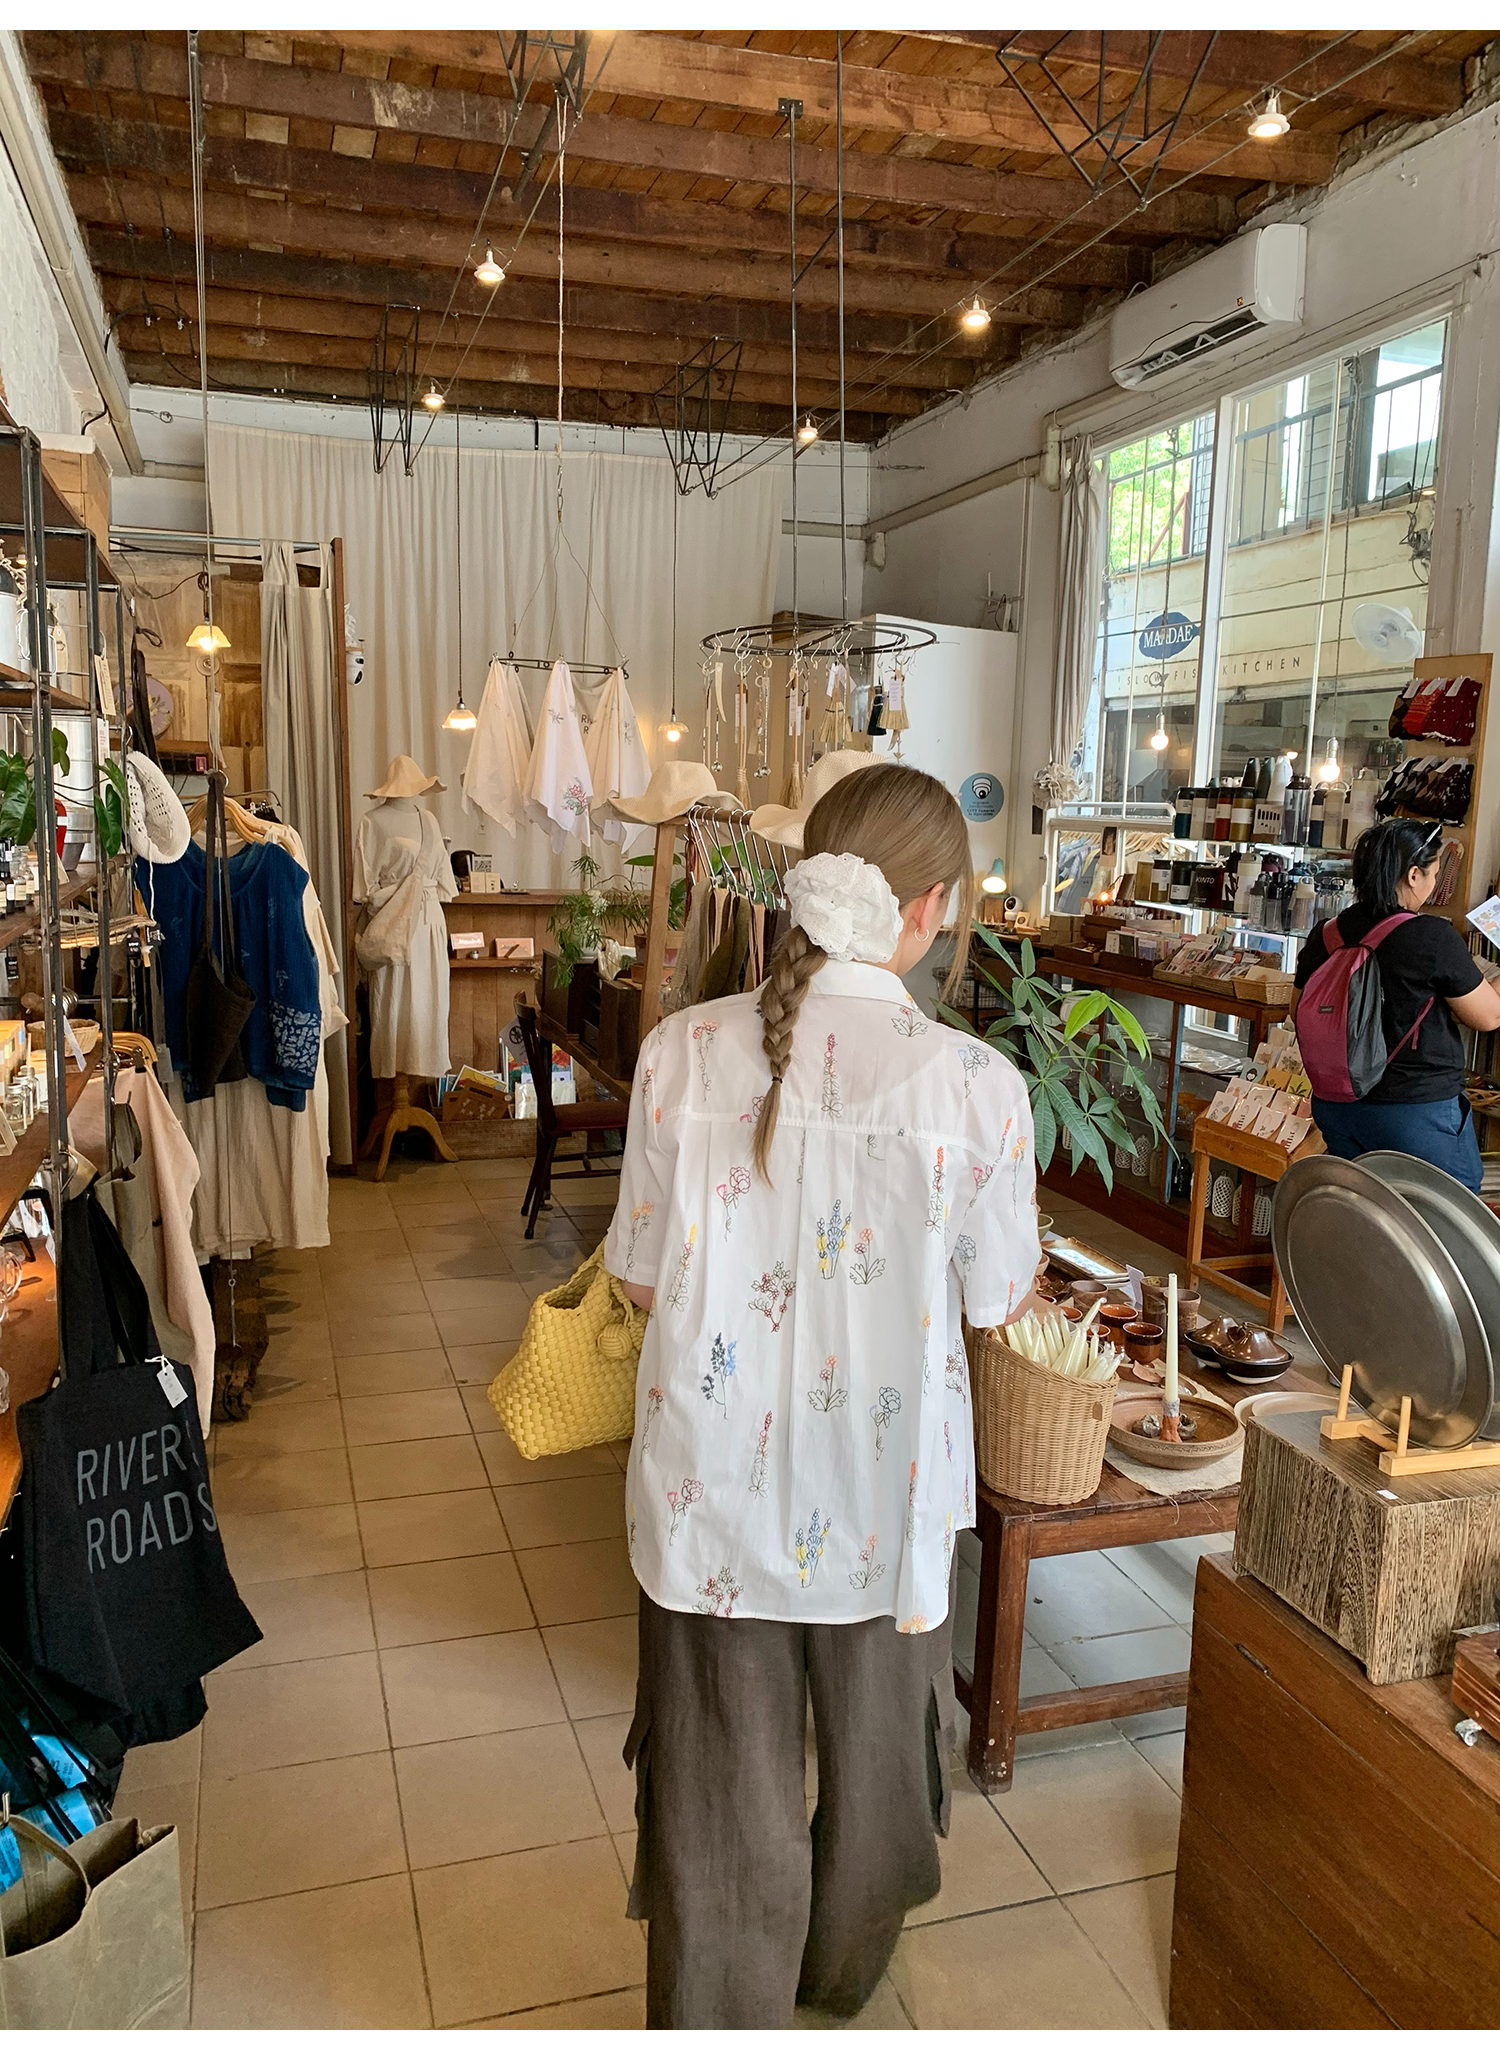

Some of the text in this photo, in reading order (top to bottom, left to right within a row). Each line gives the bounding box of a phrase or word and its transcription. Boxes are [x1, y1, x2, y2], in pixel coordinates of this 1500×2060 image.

[1173, 668, 1198, 682] FIS
[1222, 656, 1301, 676] KITCHEN
[1195, 876, 1215, 884] KINTO
[86, 1482, 217, 1574] ROADS
